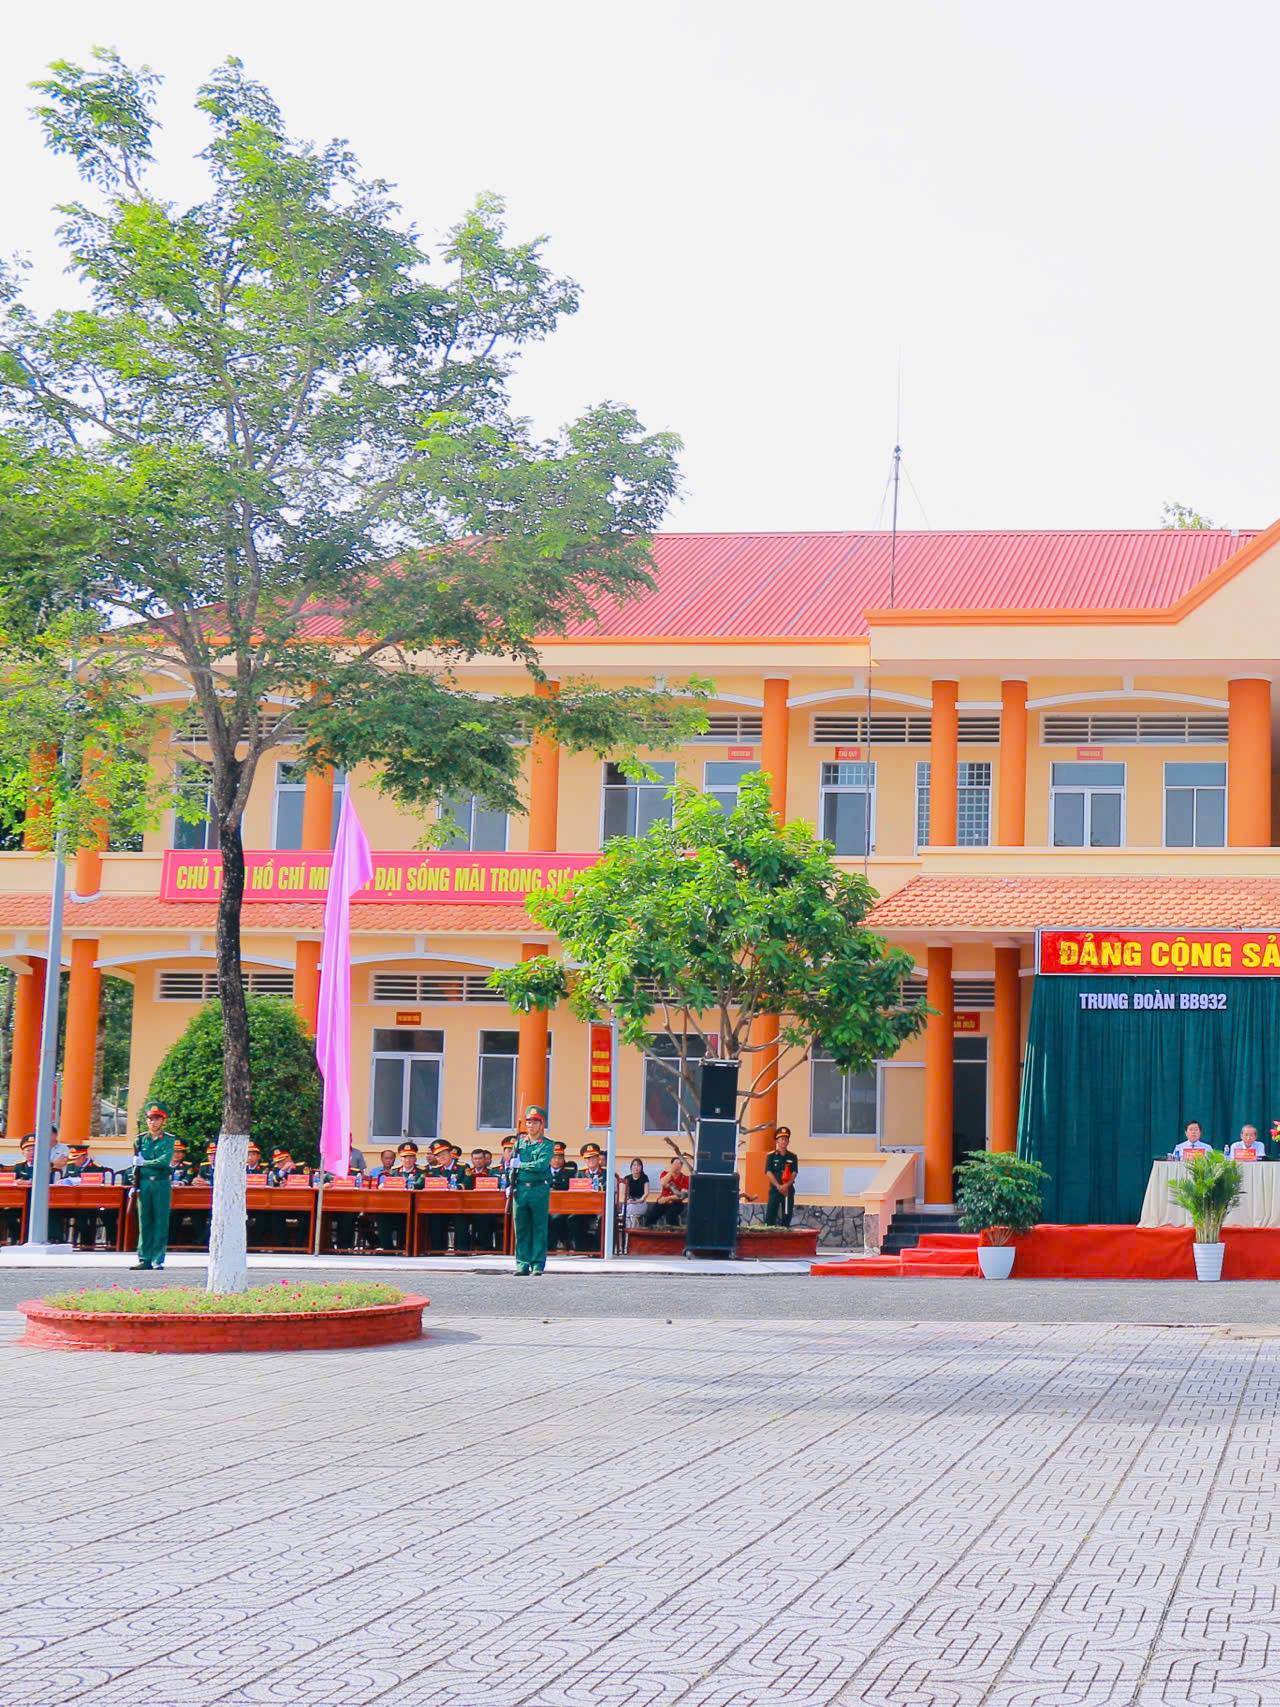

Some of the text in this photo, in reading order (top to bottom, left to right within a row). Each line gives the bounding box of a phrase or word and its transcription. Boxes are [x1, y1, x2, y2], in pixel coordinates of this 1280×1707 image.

[176, 858, 209, 890] CHỦ
[252, 858, 275, 890] HỒ
[278, 862, 306, 890] CHÍ
[374, 867, 402, 897] ĐẠI
[407, 859, 450, 892] SỐNG
[455, 864, 485, 892] MÃI
[490, 868, 542, 892] TRONG
[1059, 933, 1142, 967] ĐẢNG
[1151, 936, 1232, 971] CỘNG
[1079, 989, 1227, 1010] TRUNG ĐOÀN BB932
